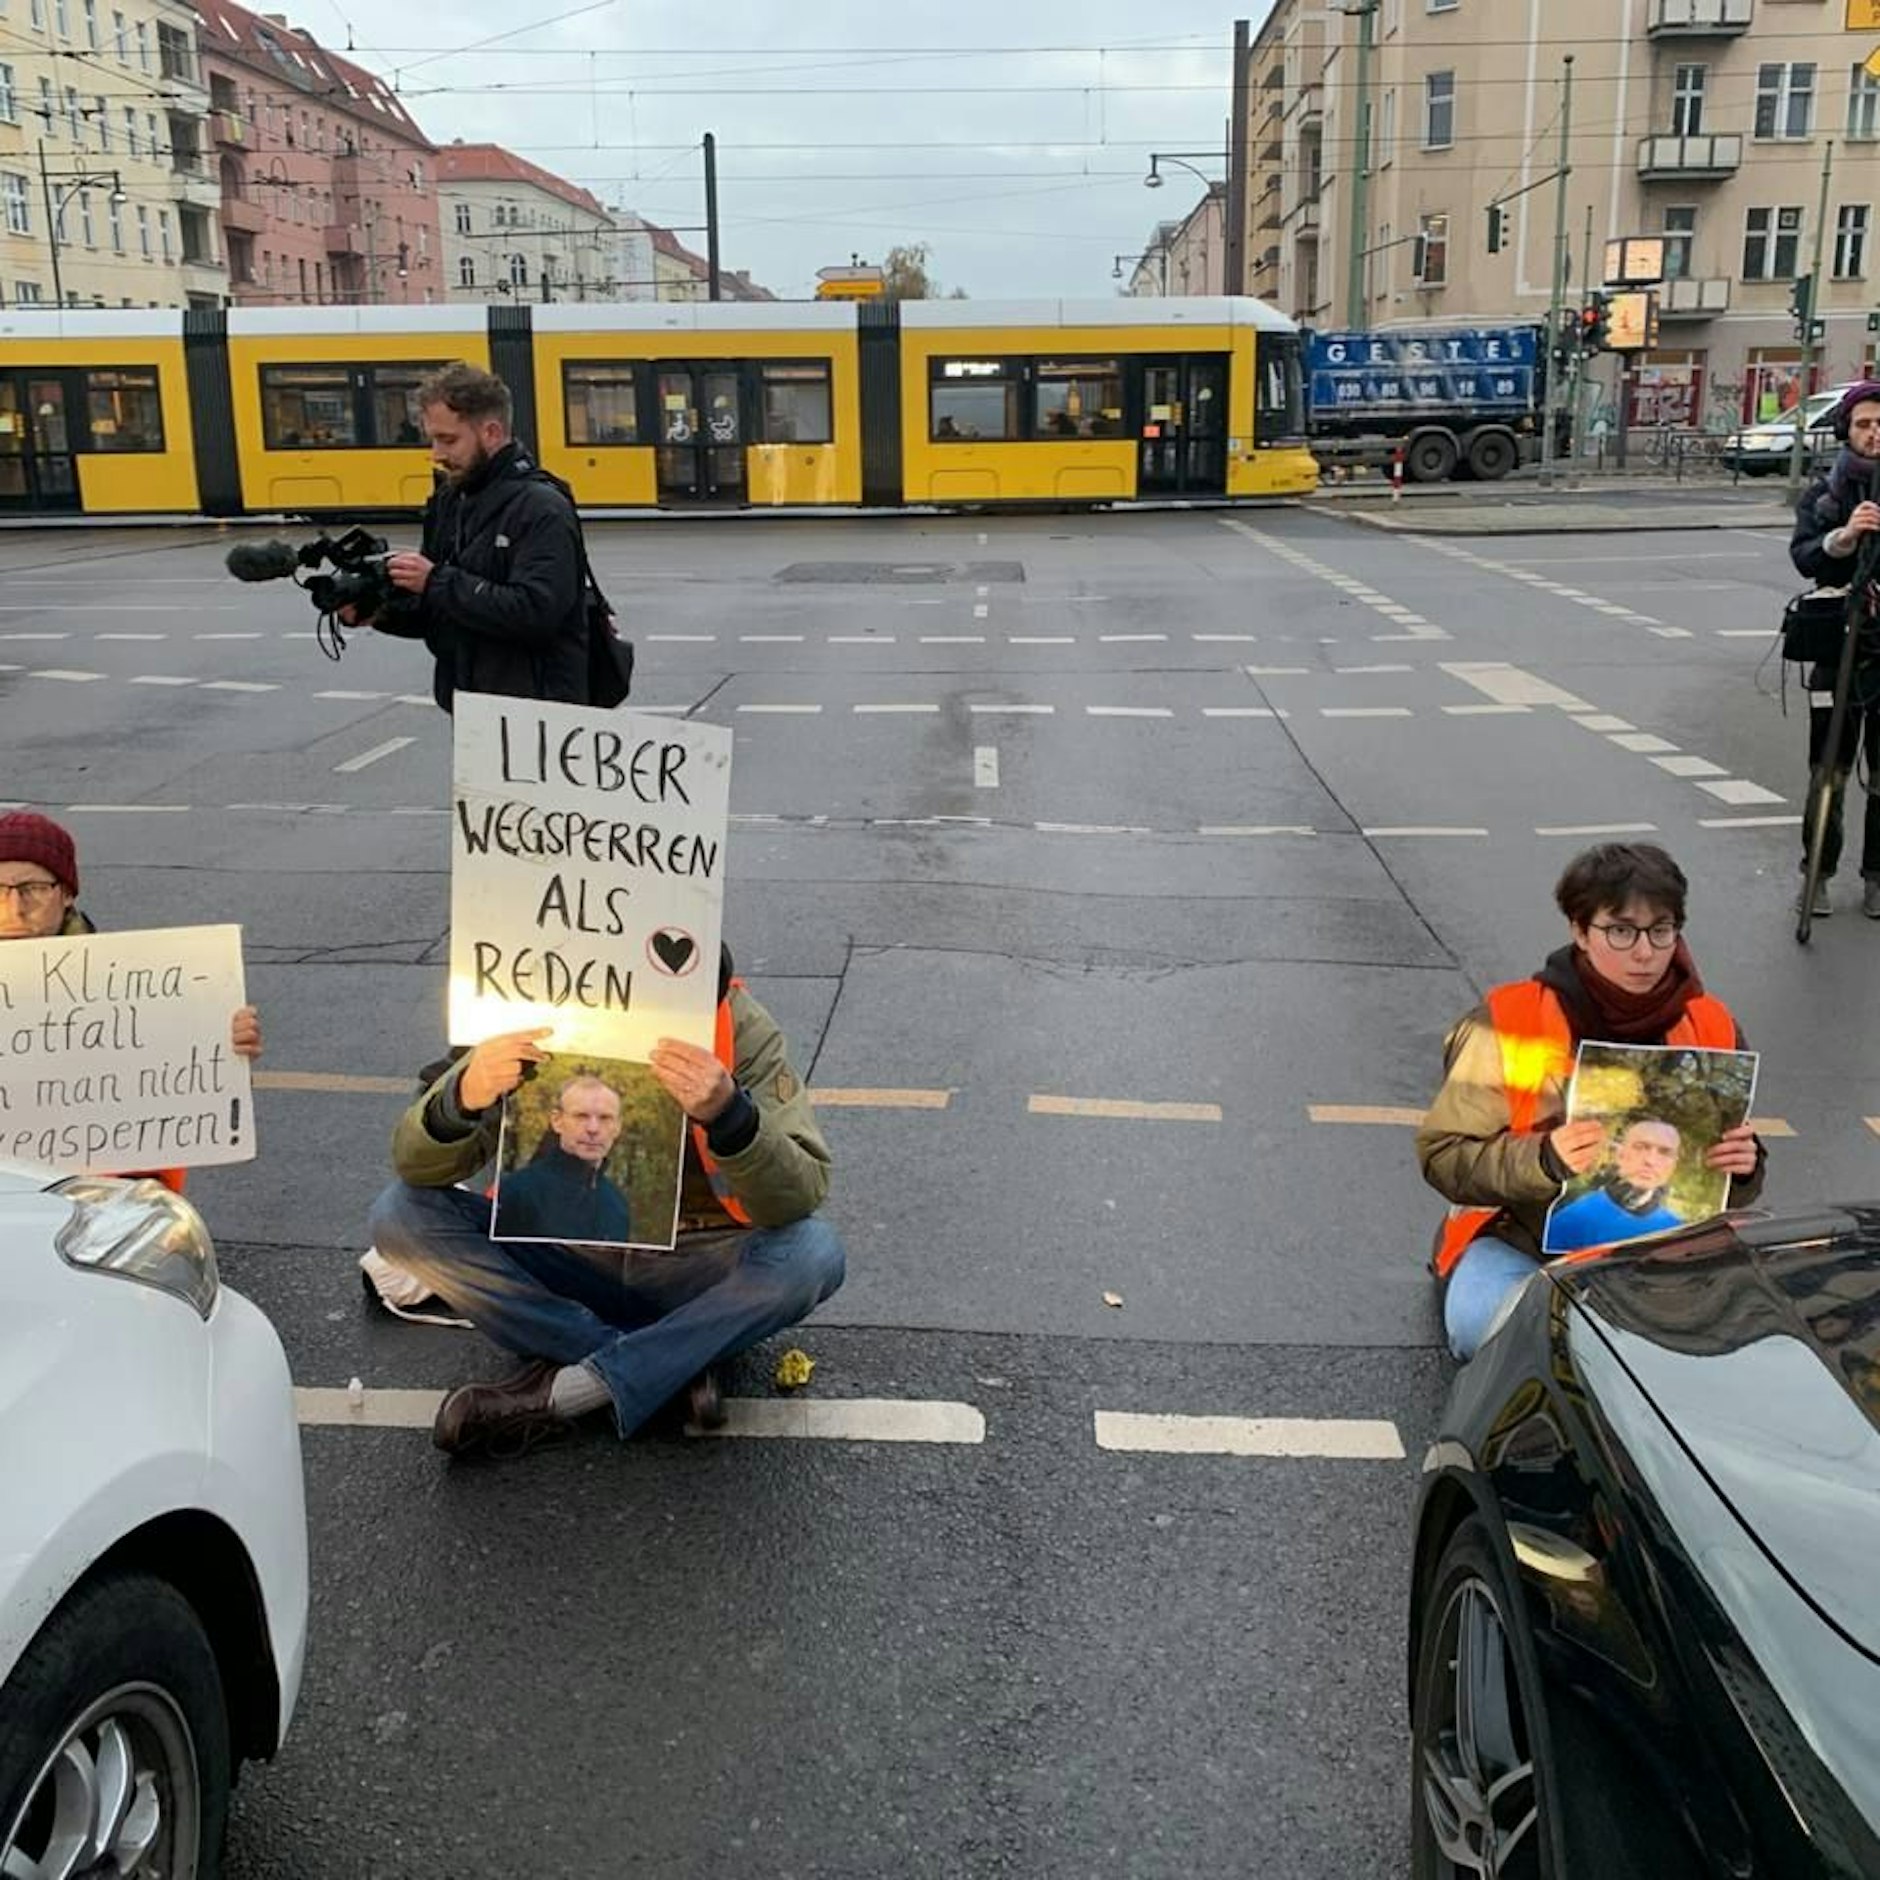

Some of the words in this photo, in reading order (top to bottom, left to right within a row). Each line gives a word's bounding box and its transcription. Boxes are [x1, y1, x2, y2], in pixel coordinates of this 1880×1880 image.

[501, 715, 690, 805] LIEBER
[457, 799, 718, 878] WEGSPERREN
[536, 873, 631, 936] ALS
[42, 947, 209, 1004] Klima-
[474, 941, 633, 1012] REDEN
[0, 1005, 145, 1056] otfall
[37, 1073, 122, 1108] man
[139, 1043, 226, 1098] nicht
[0, 1097, 240, 1168] egsperren!
